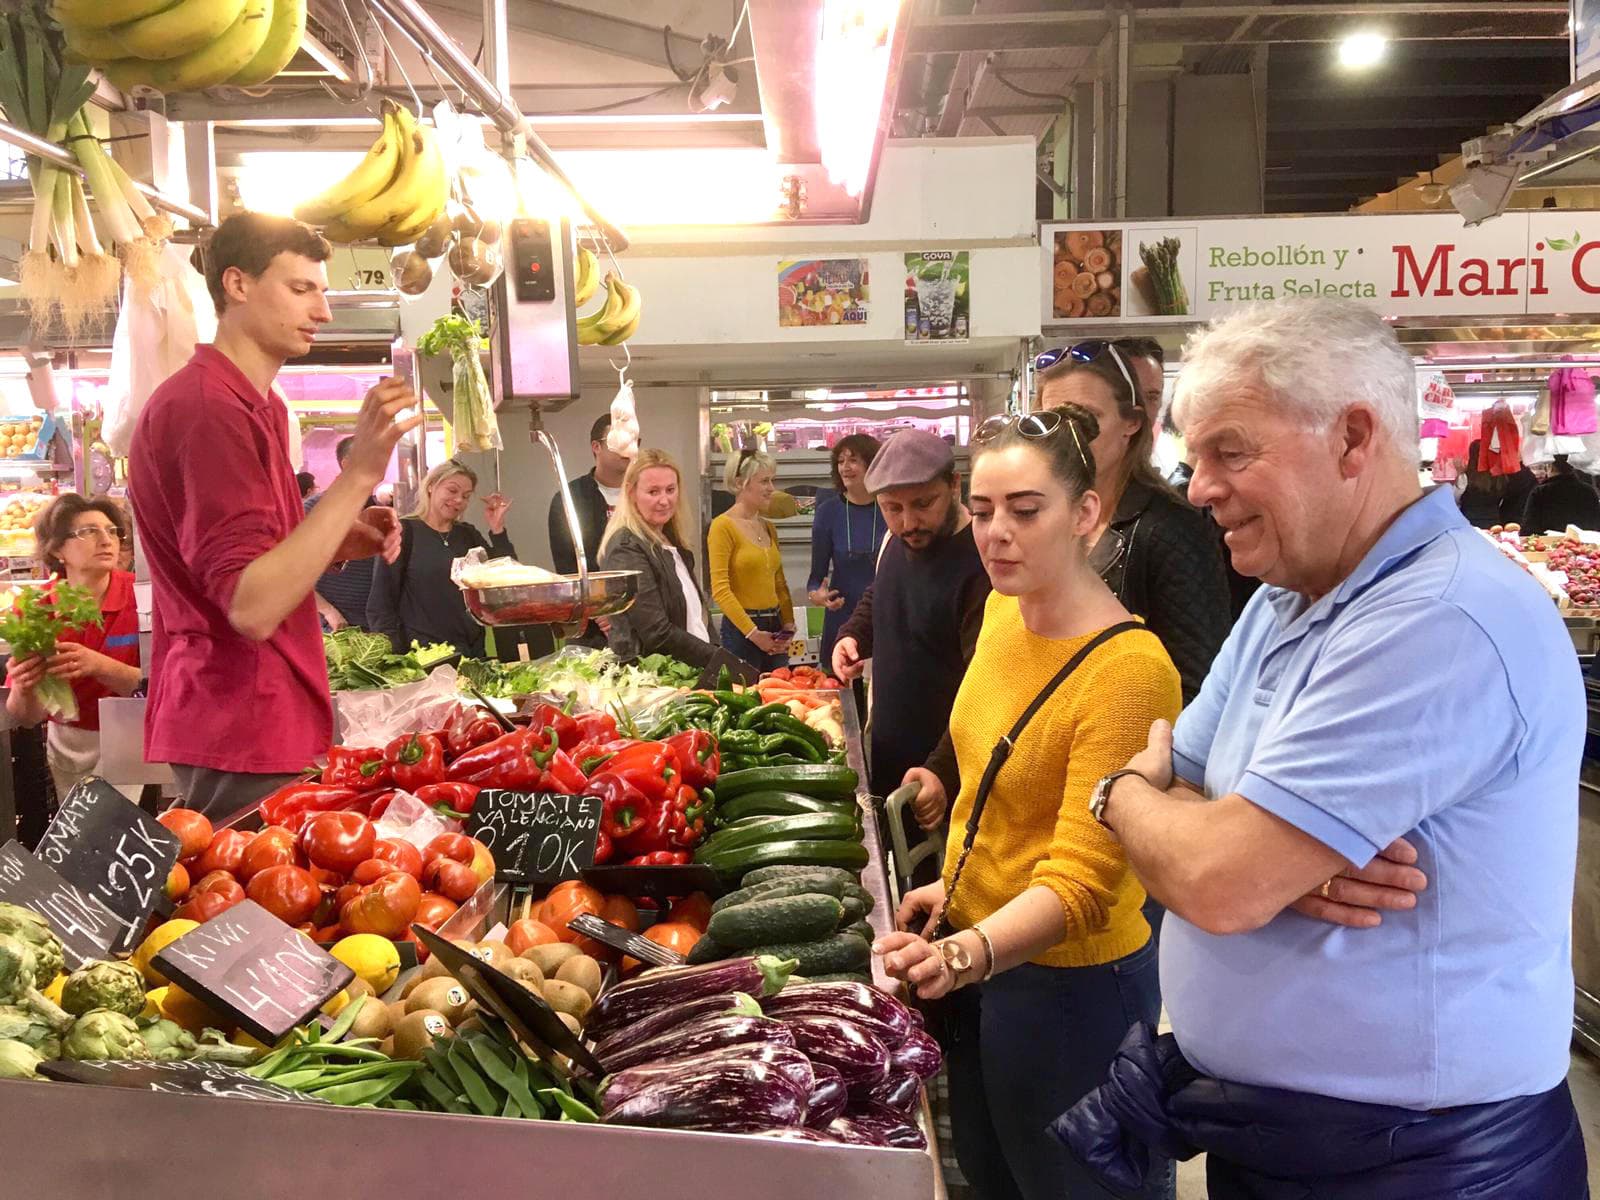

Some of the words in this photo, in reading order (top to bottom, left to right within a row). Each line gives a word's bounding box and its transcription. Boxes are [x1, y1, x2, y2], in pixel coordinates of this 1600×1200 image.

[923, 252, 951, 260] GOYA
[1209, 245, 1326, 268] Rebollón
[1333, 249, 1349, 270] y
[1391, 242, 1549, 297] Mari
[1208, 281, 1275, 301] Fruta
[1283, 279, 1377, 299] Selecta
[481, 788, 603, 813] TOMATE
[477, 808, 596, 831] VALENCIANO
[170, 922, 250, 969] KIWI
